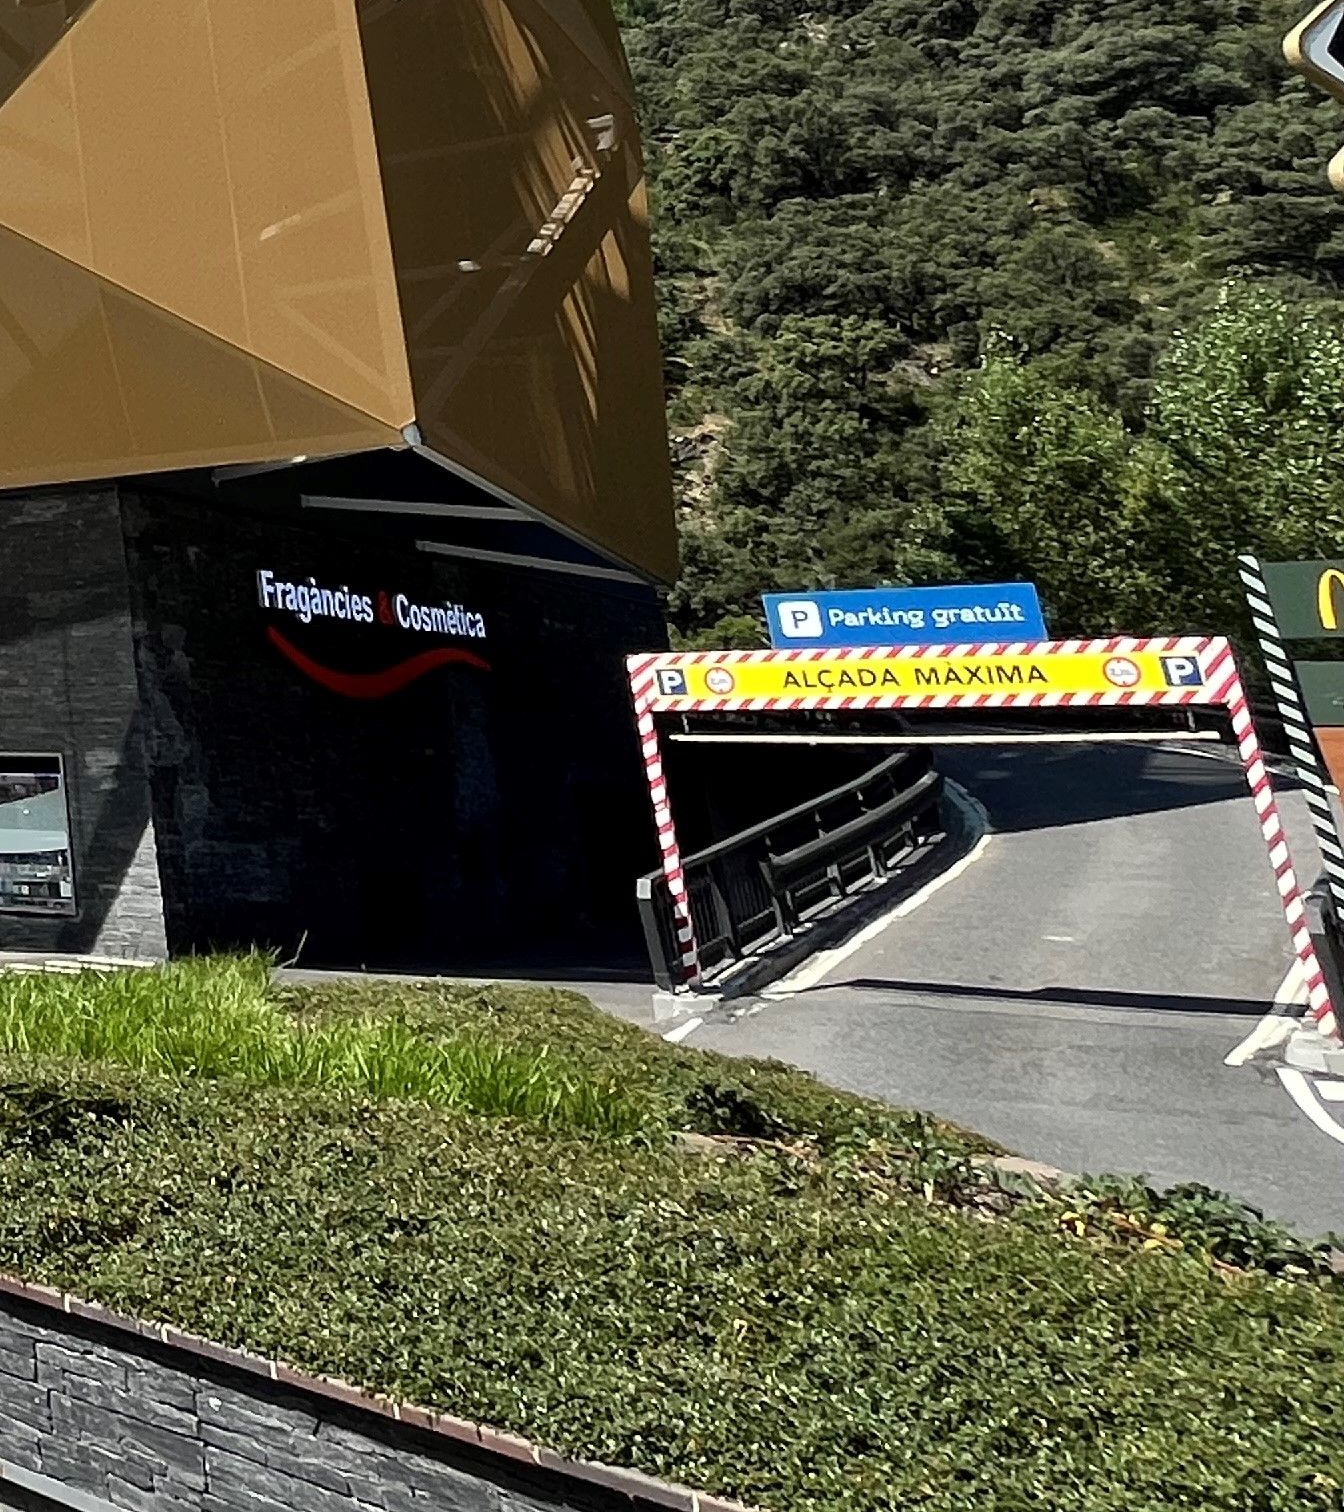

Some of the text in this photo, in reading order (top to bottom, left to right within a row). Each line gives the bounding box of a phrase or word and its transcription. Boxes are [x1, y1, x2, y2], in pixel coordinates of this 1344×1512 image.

[257, 569, 486, 638] Fragàncies & Cosmètica
[790, 610, 809, 630] P
[827, 607, 925, 629] Parking
[663, 657, 1196, 695] P ALÇADA MÀXIMA P
